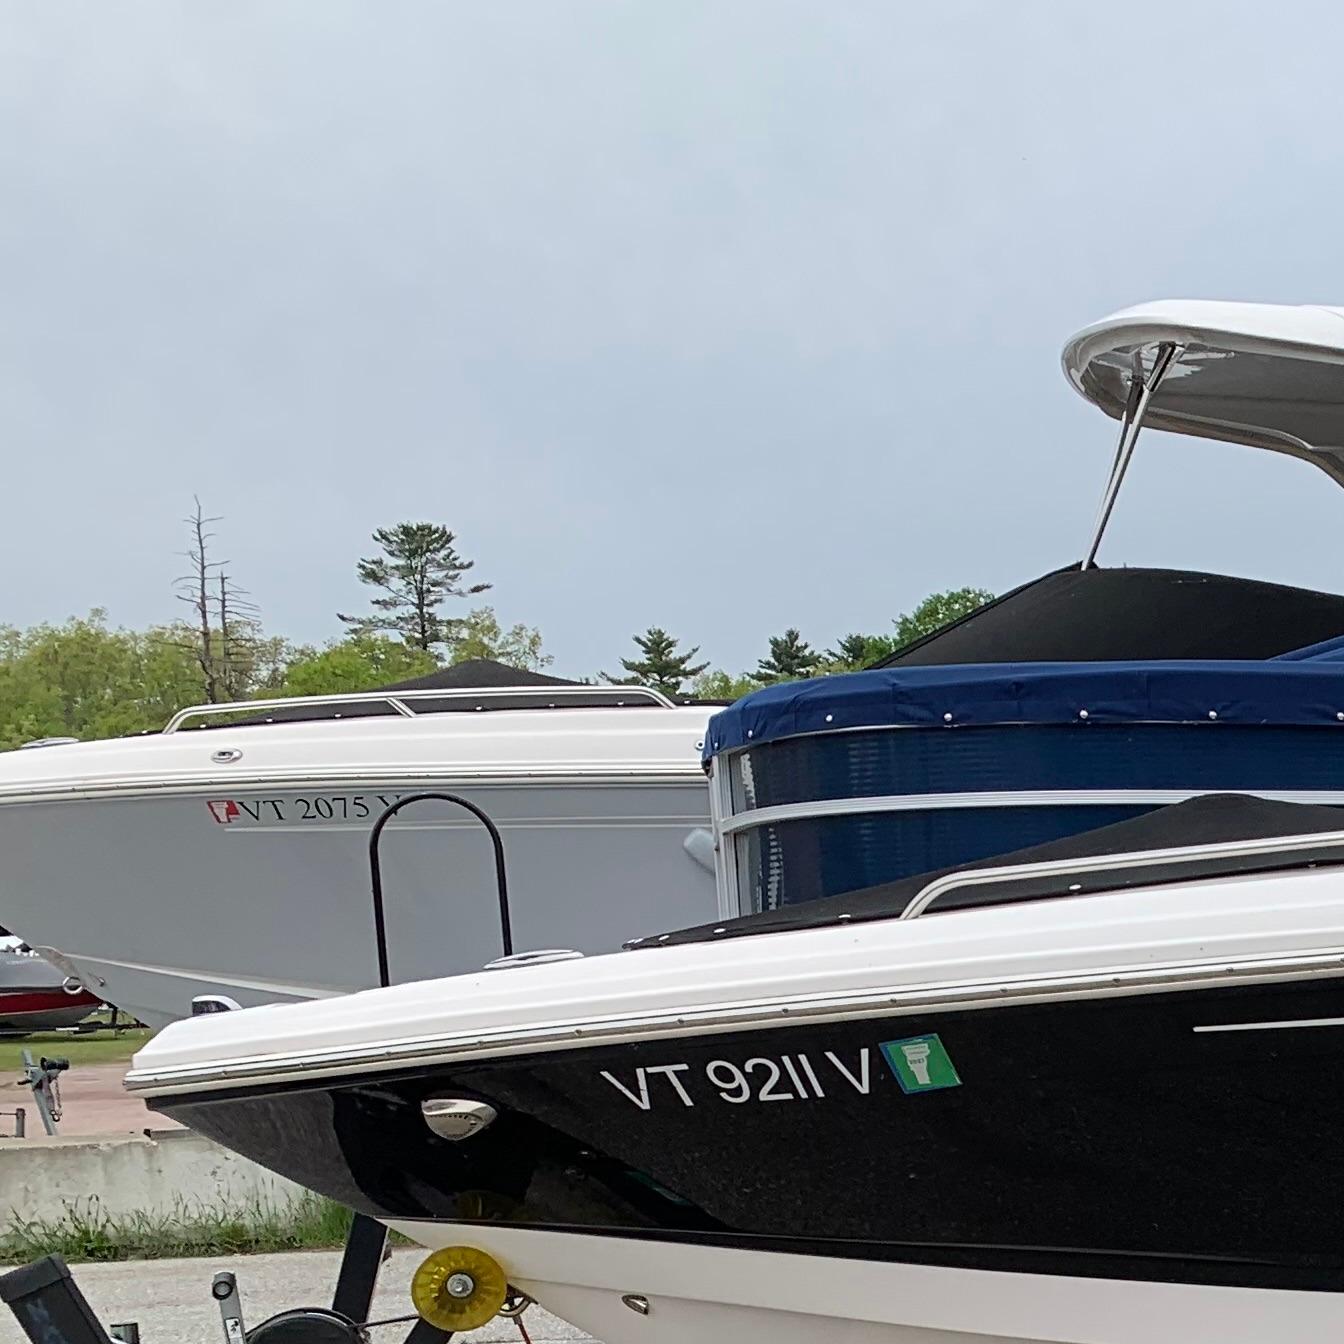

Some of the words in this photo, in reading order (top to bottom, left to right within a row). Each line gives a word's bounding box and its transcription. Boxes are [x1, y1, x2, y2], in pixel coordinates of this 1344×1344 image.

[238, 800, 286, 820] VT
[295, 796, 370, 819] 2075
[600, 1063, 694, 1110] VT
[824, 1048, 869, 1094] V
